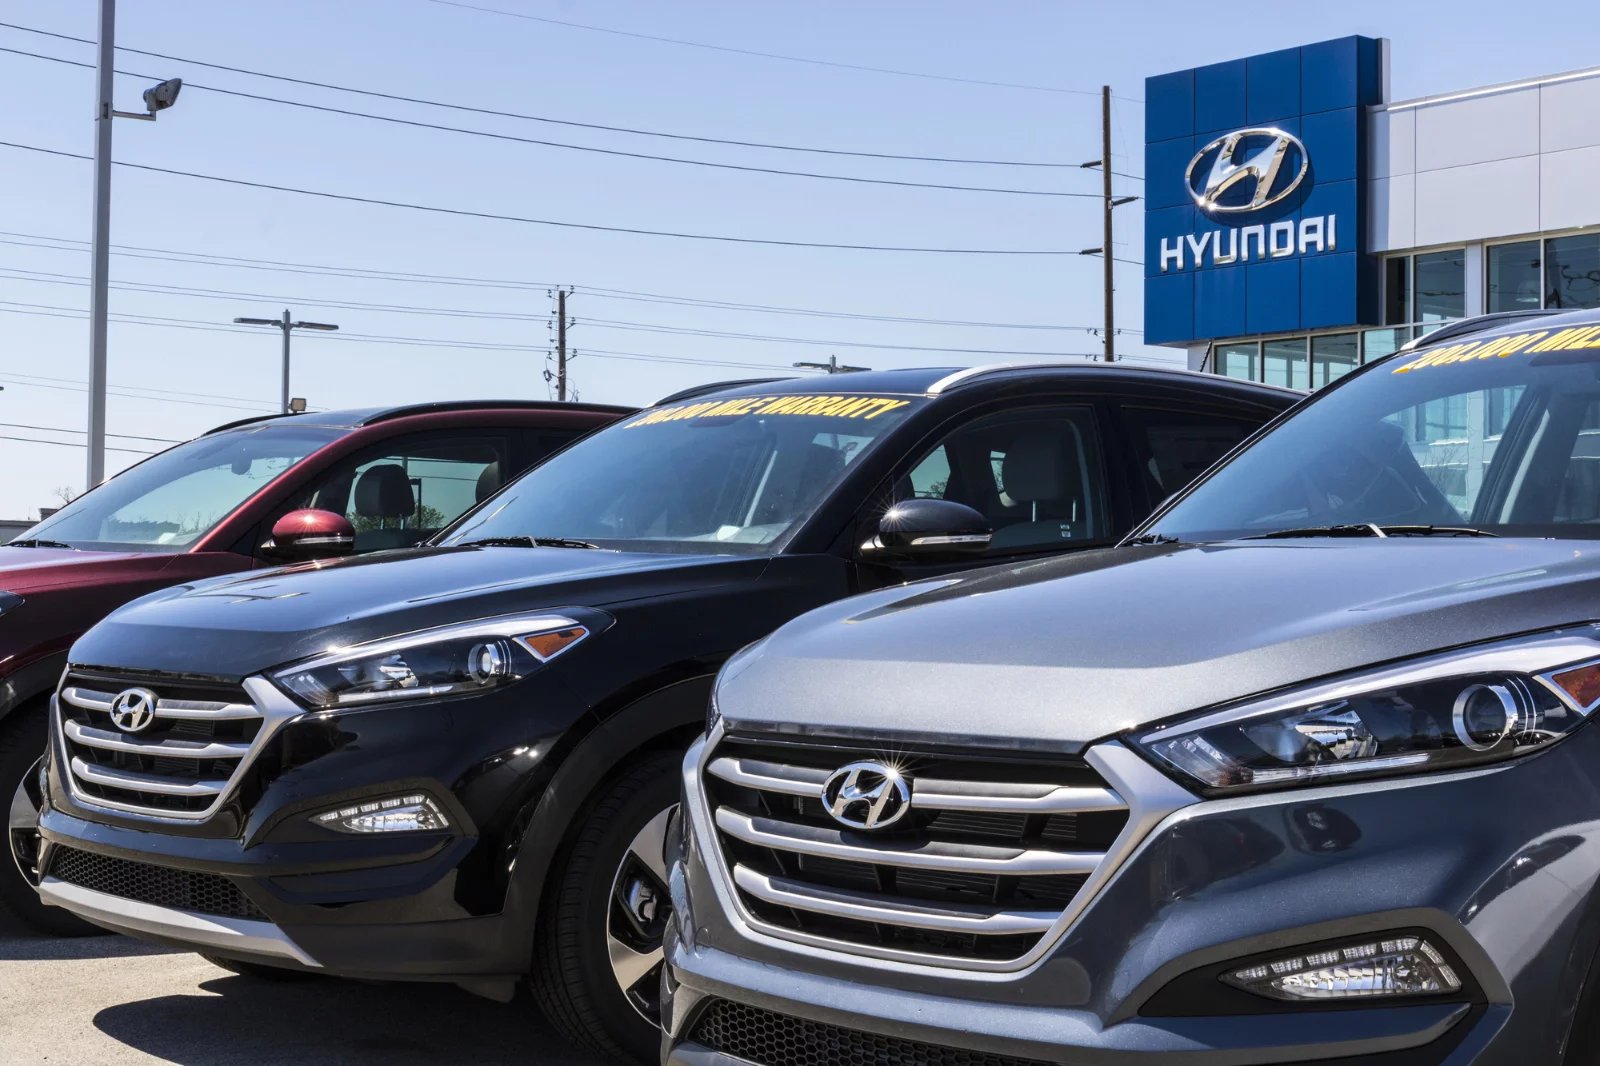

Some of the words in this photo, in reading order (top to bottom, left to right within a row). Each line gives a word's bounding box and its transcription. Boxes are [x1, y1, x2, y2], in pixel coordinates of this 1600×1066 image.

[1160, 214, 1336, 272] HYUNDAI
[1523, 325, 1600, 354] MIL
[753, 395, 911, 420] WARRANTY
